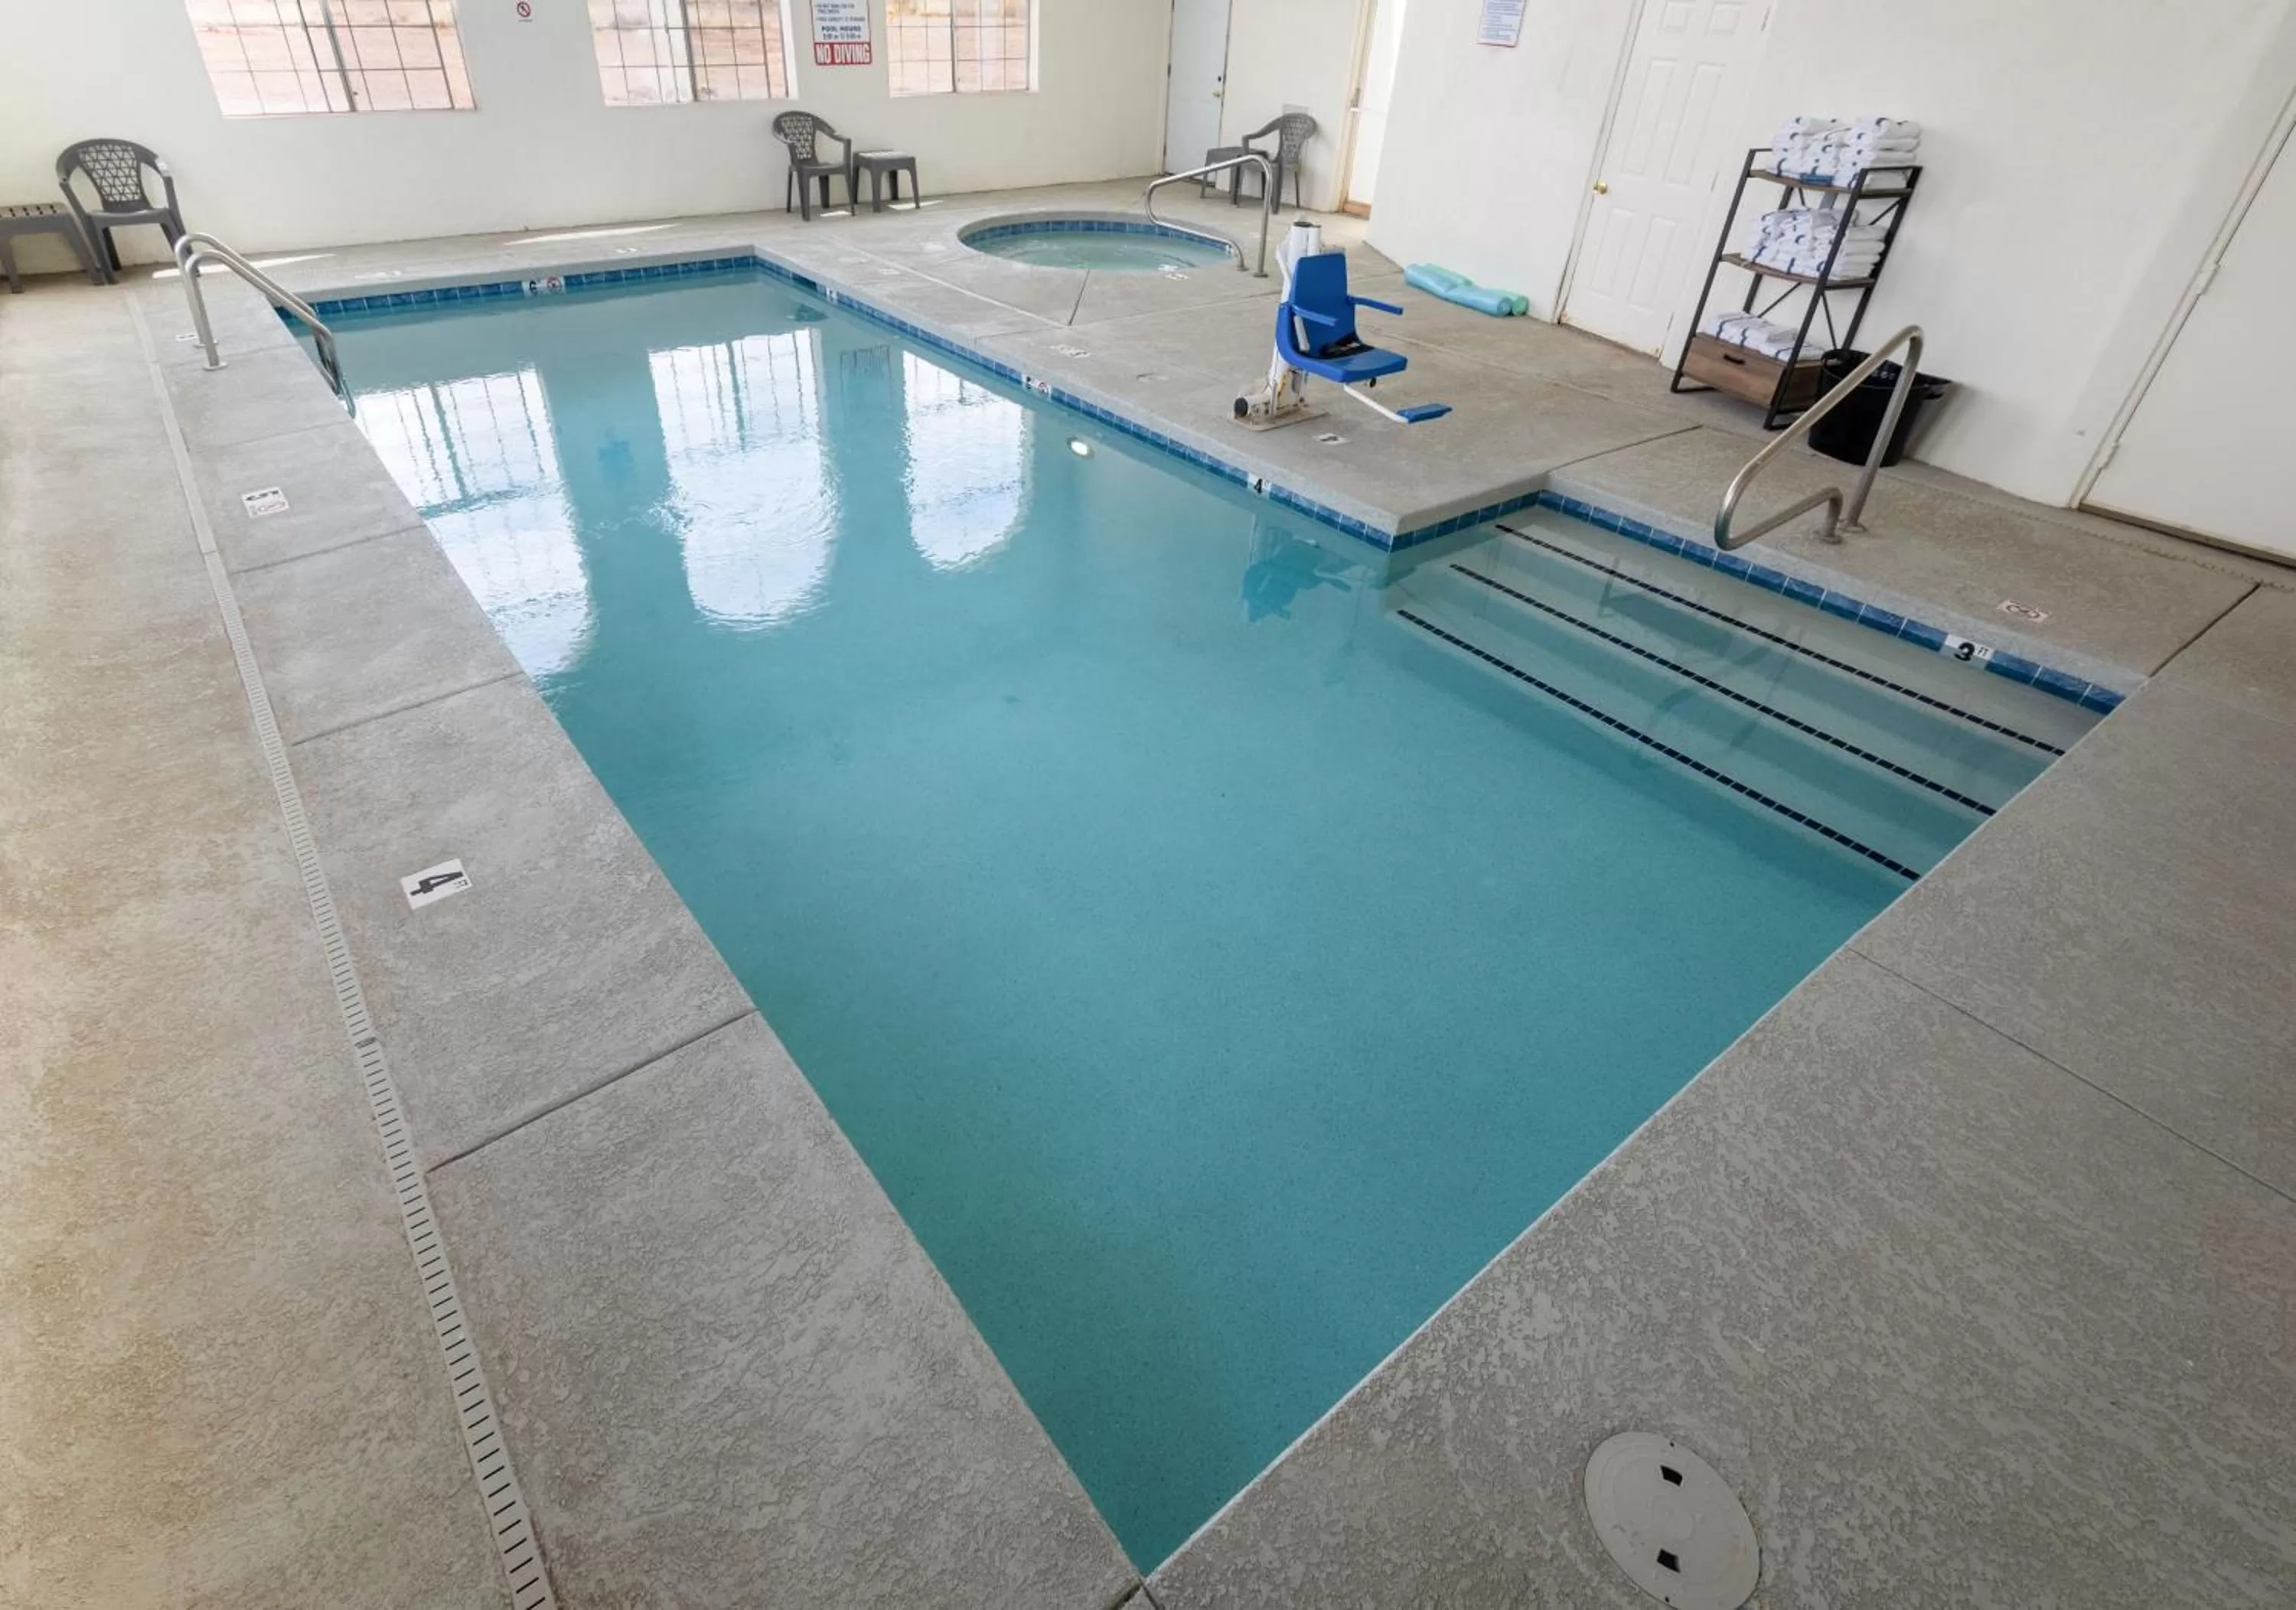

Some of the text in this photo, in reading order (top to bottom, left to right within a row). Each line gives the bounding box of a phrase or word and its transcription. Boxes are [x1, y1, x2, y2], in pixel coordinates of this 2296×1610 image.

[815, 44, 870, 64] NO DIVING
[1254, 478, 1263, 494] 4
[1954, 642, 1975, 661] 3
[410, 872, 463, 896] 4
